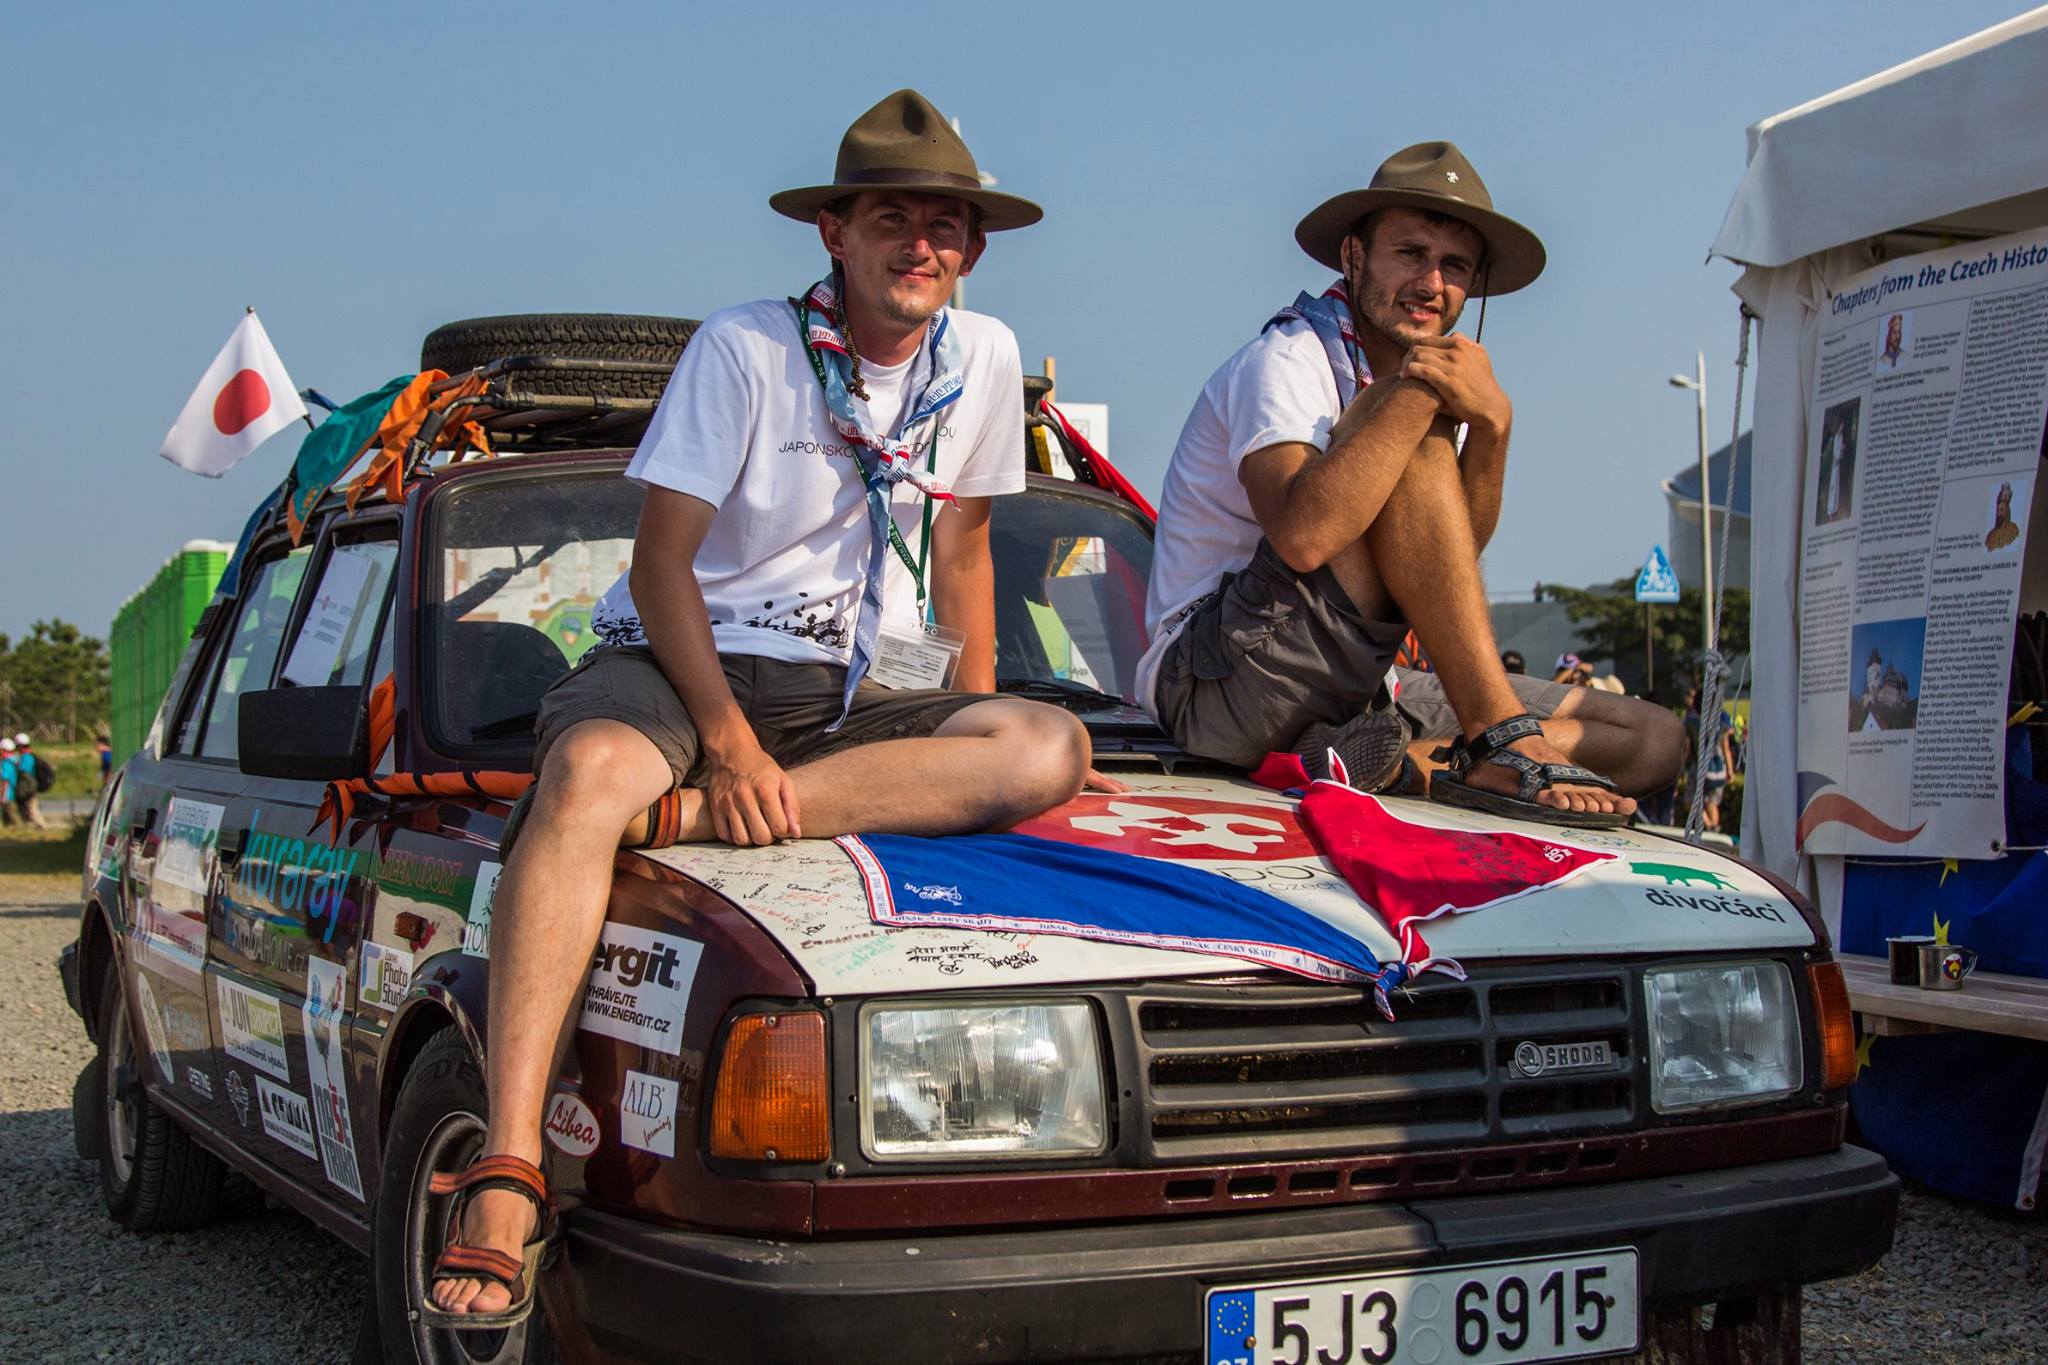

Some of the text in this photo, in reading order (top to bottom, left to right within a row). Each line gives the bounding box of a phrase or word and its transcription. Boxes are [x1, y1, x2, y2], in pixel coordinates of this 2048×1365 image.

[1832, 283, 1877, 315] Chapters
[1877, 272, 1914, 304] from
[1918, 265, 1945, 288] the
[1949, 253, 1997, 282] Czech
[239, 809, 359, 944] kuraray
[1646, 888, 1786, 923] divočáci
[384, 961, 408, 987] Photo
[594, 941, 680, 990] ergit
[382, 983, 406, 1007] Stud
[586, 985, 638, 1009] YHRÁVEJTE
[587, 1001, 672, 1034] WWW.ENERGIT.CZ
[624, 1079, 662, 1119] ALB
[546, 1099, 596, 1145] Libea
[1271, 1265, 1608, 1365] 5J3 6915
